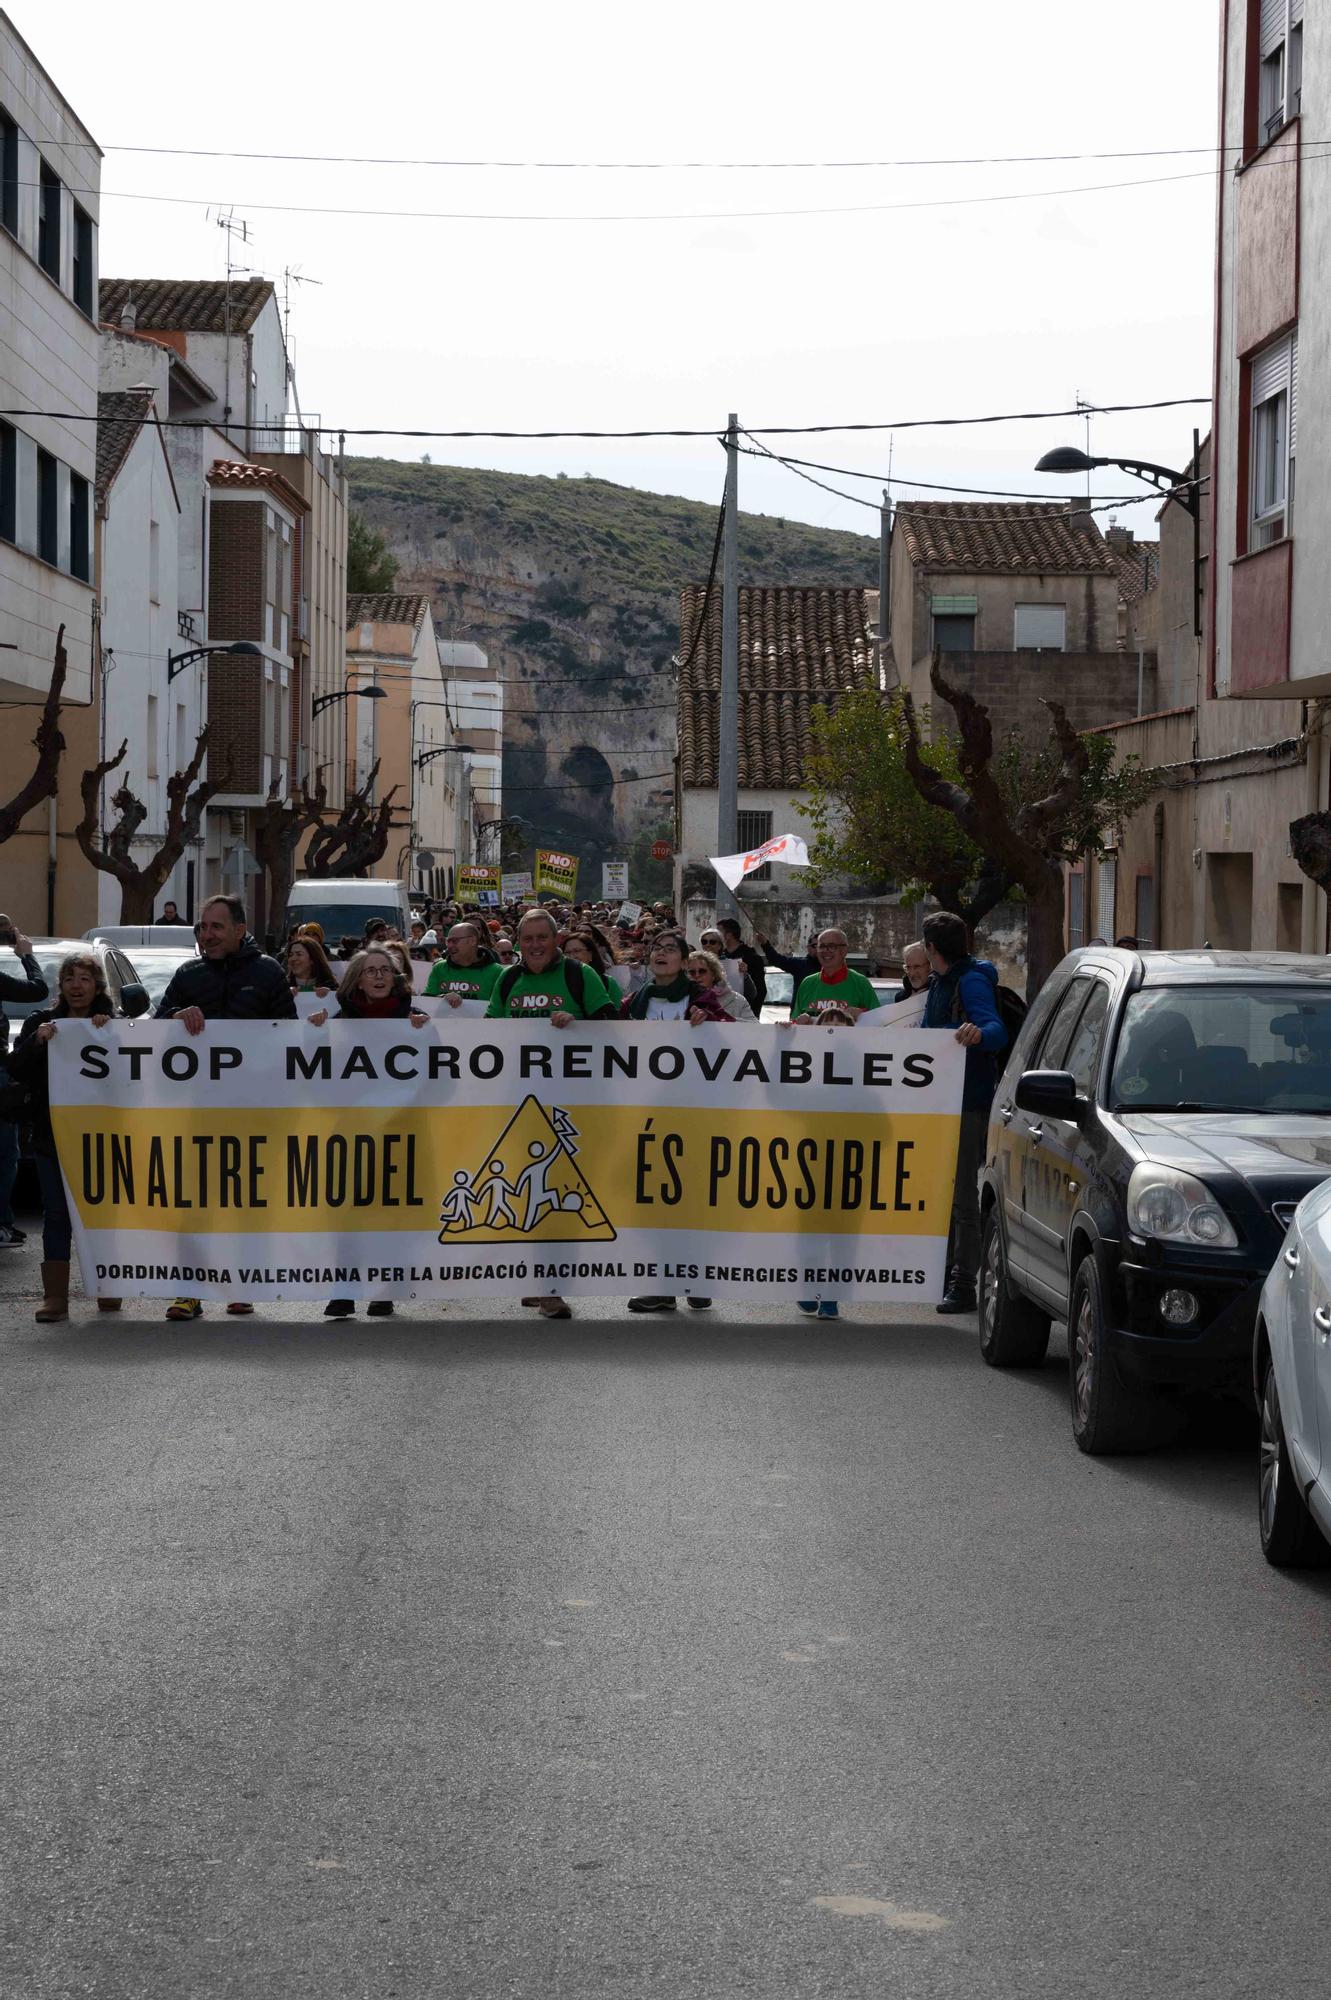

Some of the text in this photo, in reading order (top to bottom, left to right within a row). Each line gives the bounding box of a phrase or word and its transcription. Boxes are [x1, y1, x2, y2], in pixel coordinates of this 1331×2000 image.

[652, 847, 671, 855] STOP
[549, 854, 571, 867] NO
[470, 868, 489, 877] NO
[461, 877, 498, 886] MAGDA
[449, 982, 470, 991] NO
[522, 995, 549, 1007] NO
[816, 1000, 838, 1009] NO
[511, 1008, 551, 1018] MAGD
[79, 1044, 935, 1088] STOP MACRORENOVABLES
[82, 1132, 135, 1205] UN
[147, 1135, 268, 1208] ALTRE
[287, 1134, 424, 1208] MODEL
[635, 1117, 684, 1206] ÉS
[709, 1136, 925, 1211] POSSIBLE.
[238, 1268, 362, 1284] VALENCIANA
[367, 1267, 405, 1282] PER
[410, 1266, 433, 1282] LA
[440, 1260, 528, 1281] UBICACIÓ
[533, 1262, 628, 1279] RACIONAL
[634, 1262, 658, 1278] DE
[663, 1263, 699, 1279] LES
[704, 1266, 798, 1283] ENERGIES
[803, 1268, 926, 1284] RENOVABLES
